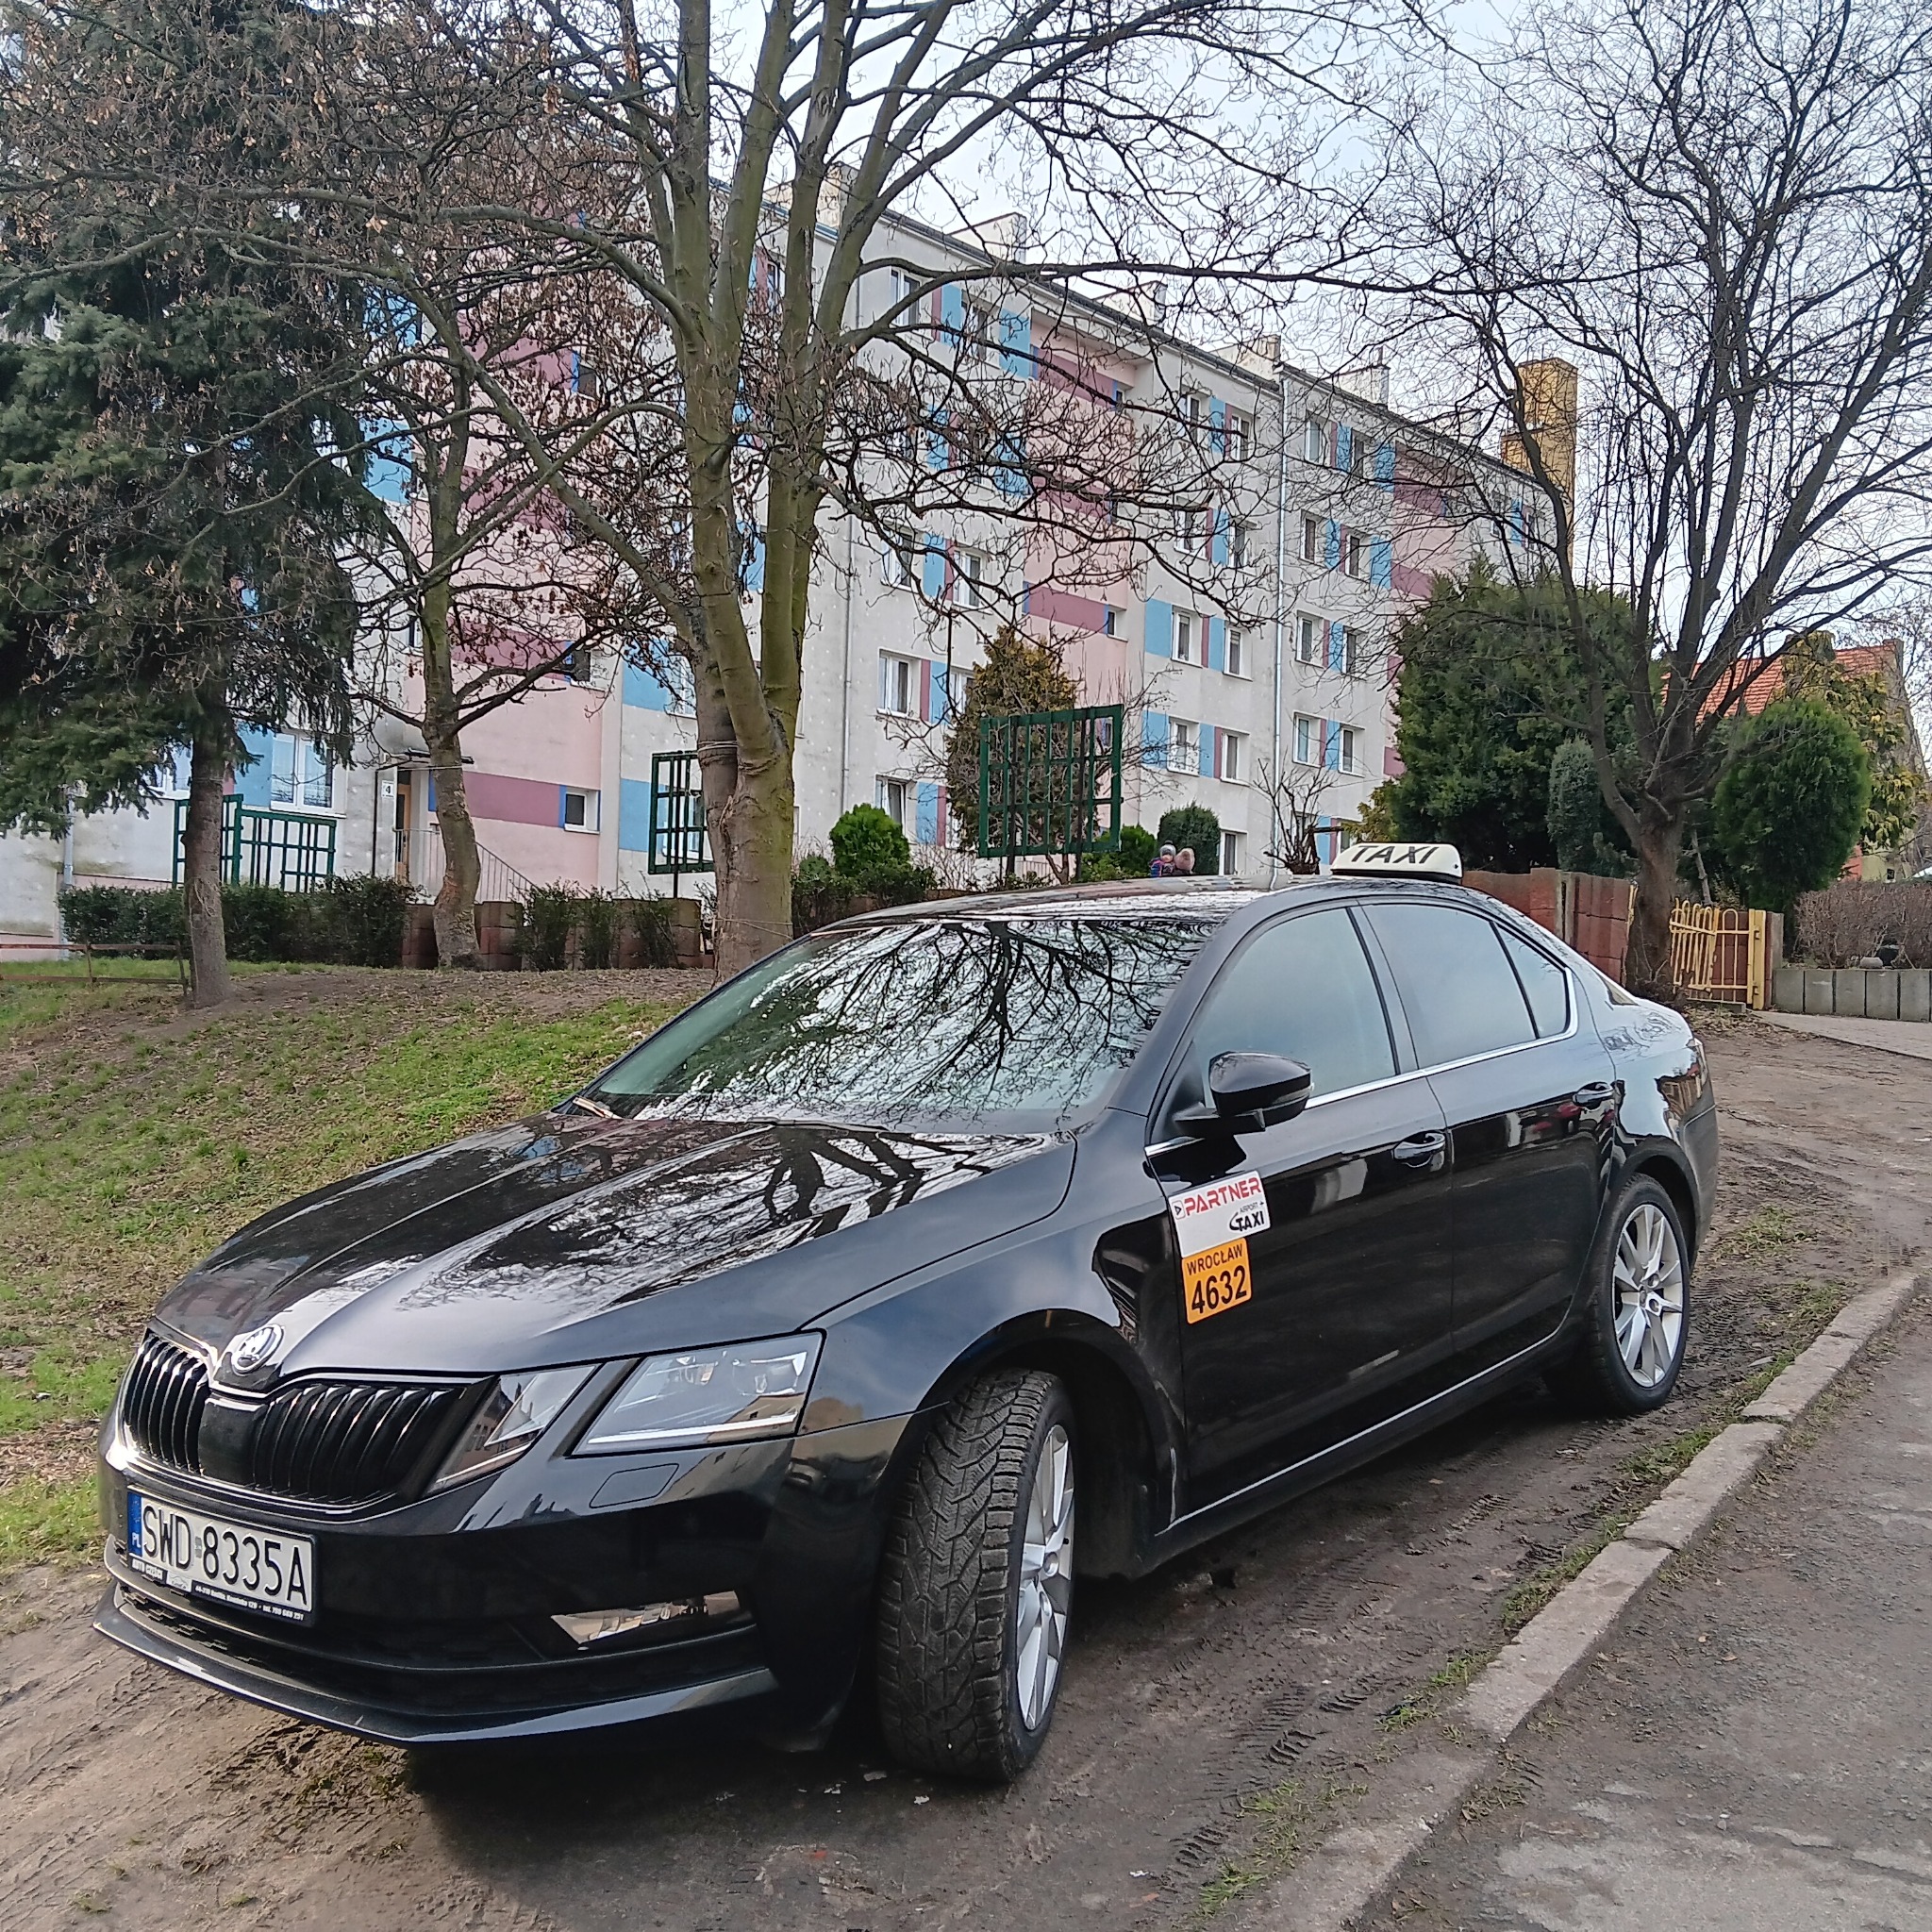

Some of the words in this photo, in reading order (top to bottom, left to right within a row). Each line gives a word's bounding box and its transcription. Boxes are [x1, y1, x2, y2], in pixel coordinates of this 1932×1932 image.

[1351, 845, 1440, 864] TAXI
[1184, 1176, 1262, 1217] PARTNER
[1240, 1201, 1259, 1214] AIRPORT
[1234, 1210, 1265, 1232] TAXI
[1187, 1242, 1243, 1276] WROCŁAW
[1191, 1265, 1248, 1314] 4632
[131, 1532, 142, 1548] PL
[142, 1506, 192, 1570] SWD
[202, 1525, 308, 1606] 8335A
